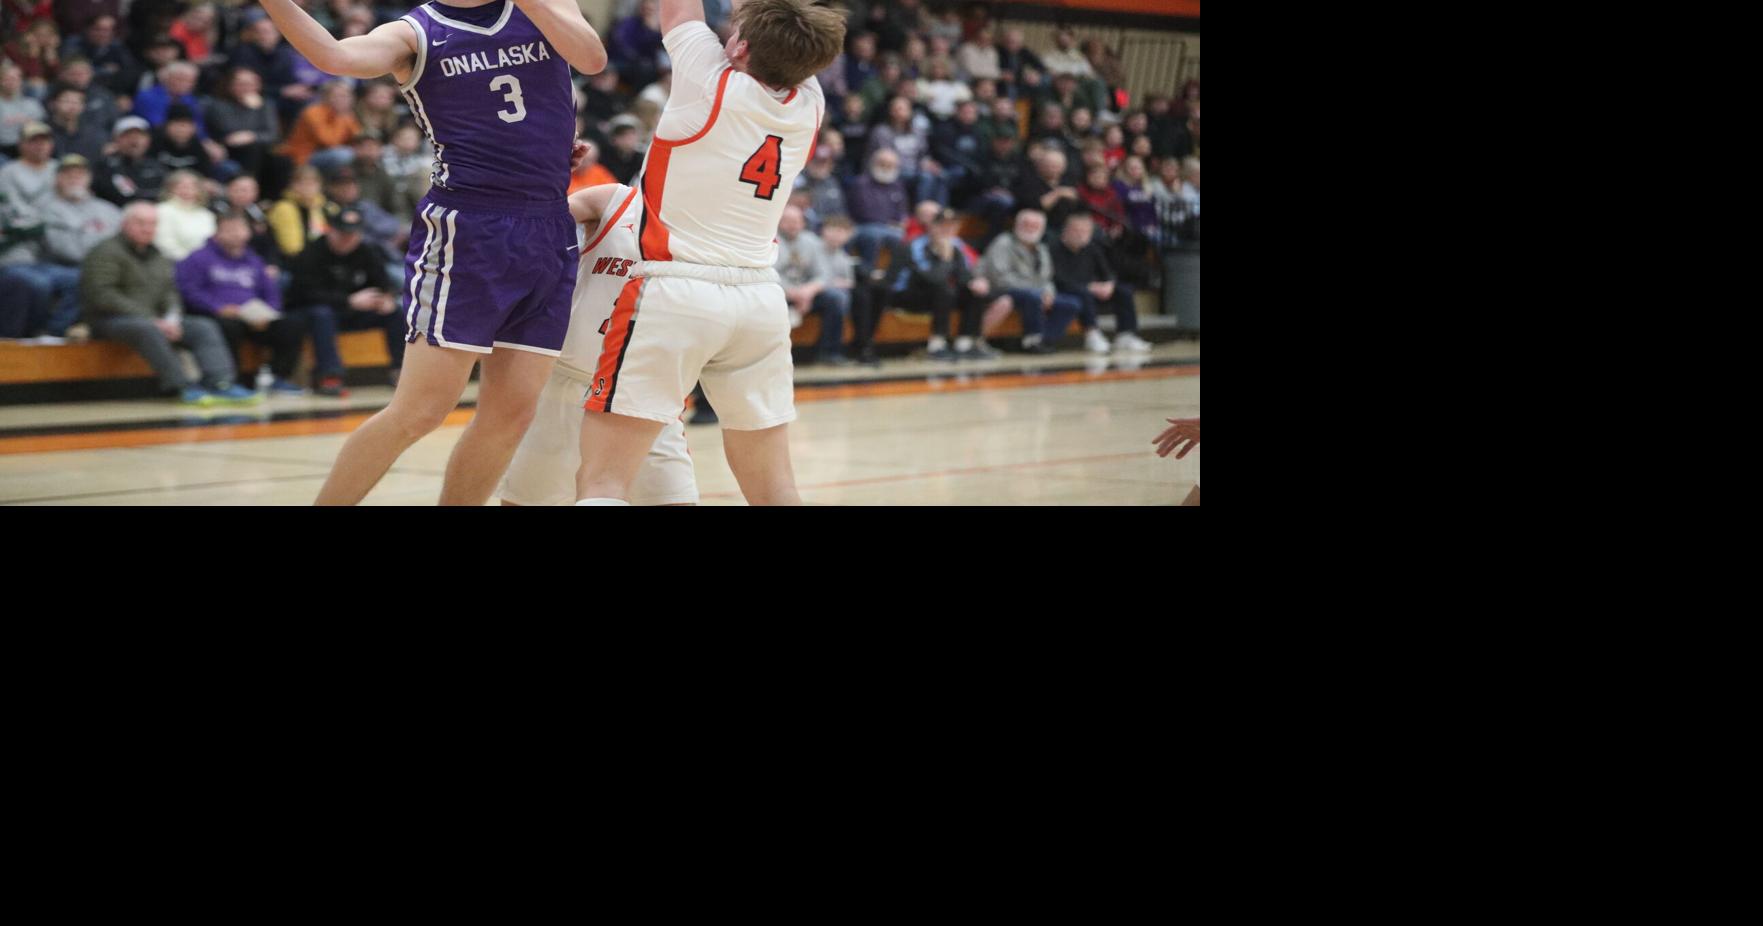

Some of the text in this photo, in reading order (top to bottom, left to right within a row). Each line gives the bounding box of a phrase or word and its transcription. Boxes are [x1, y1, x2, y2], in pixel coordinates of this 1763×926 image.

[440, 41, 550, 78] ONALASKA
[489, 74, 527, 123] 3
[739, 134, 783, 200] 4
[592, 256, 636, 279] WES
